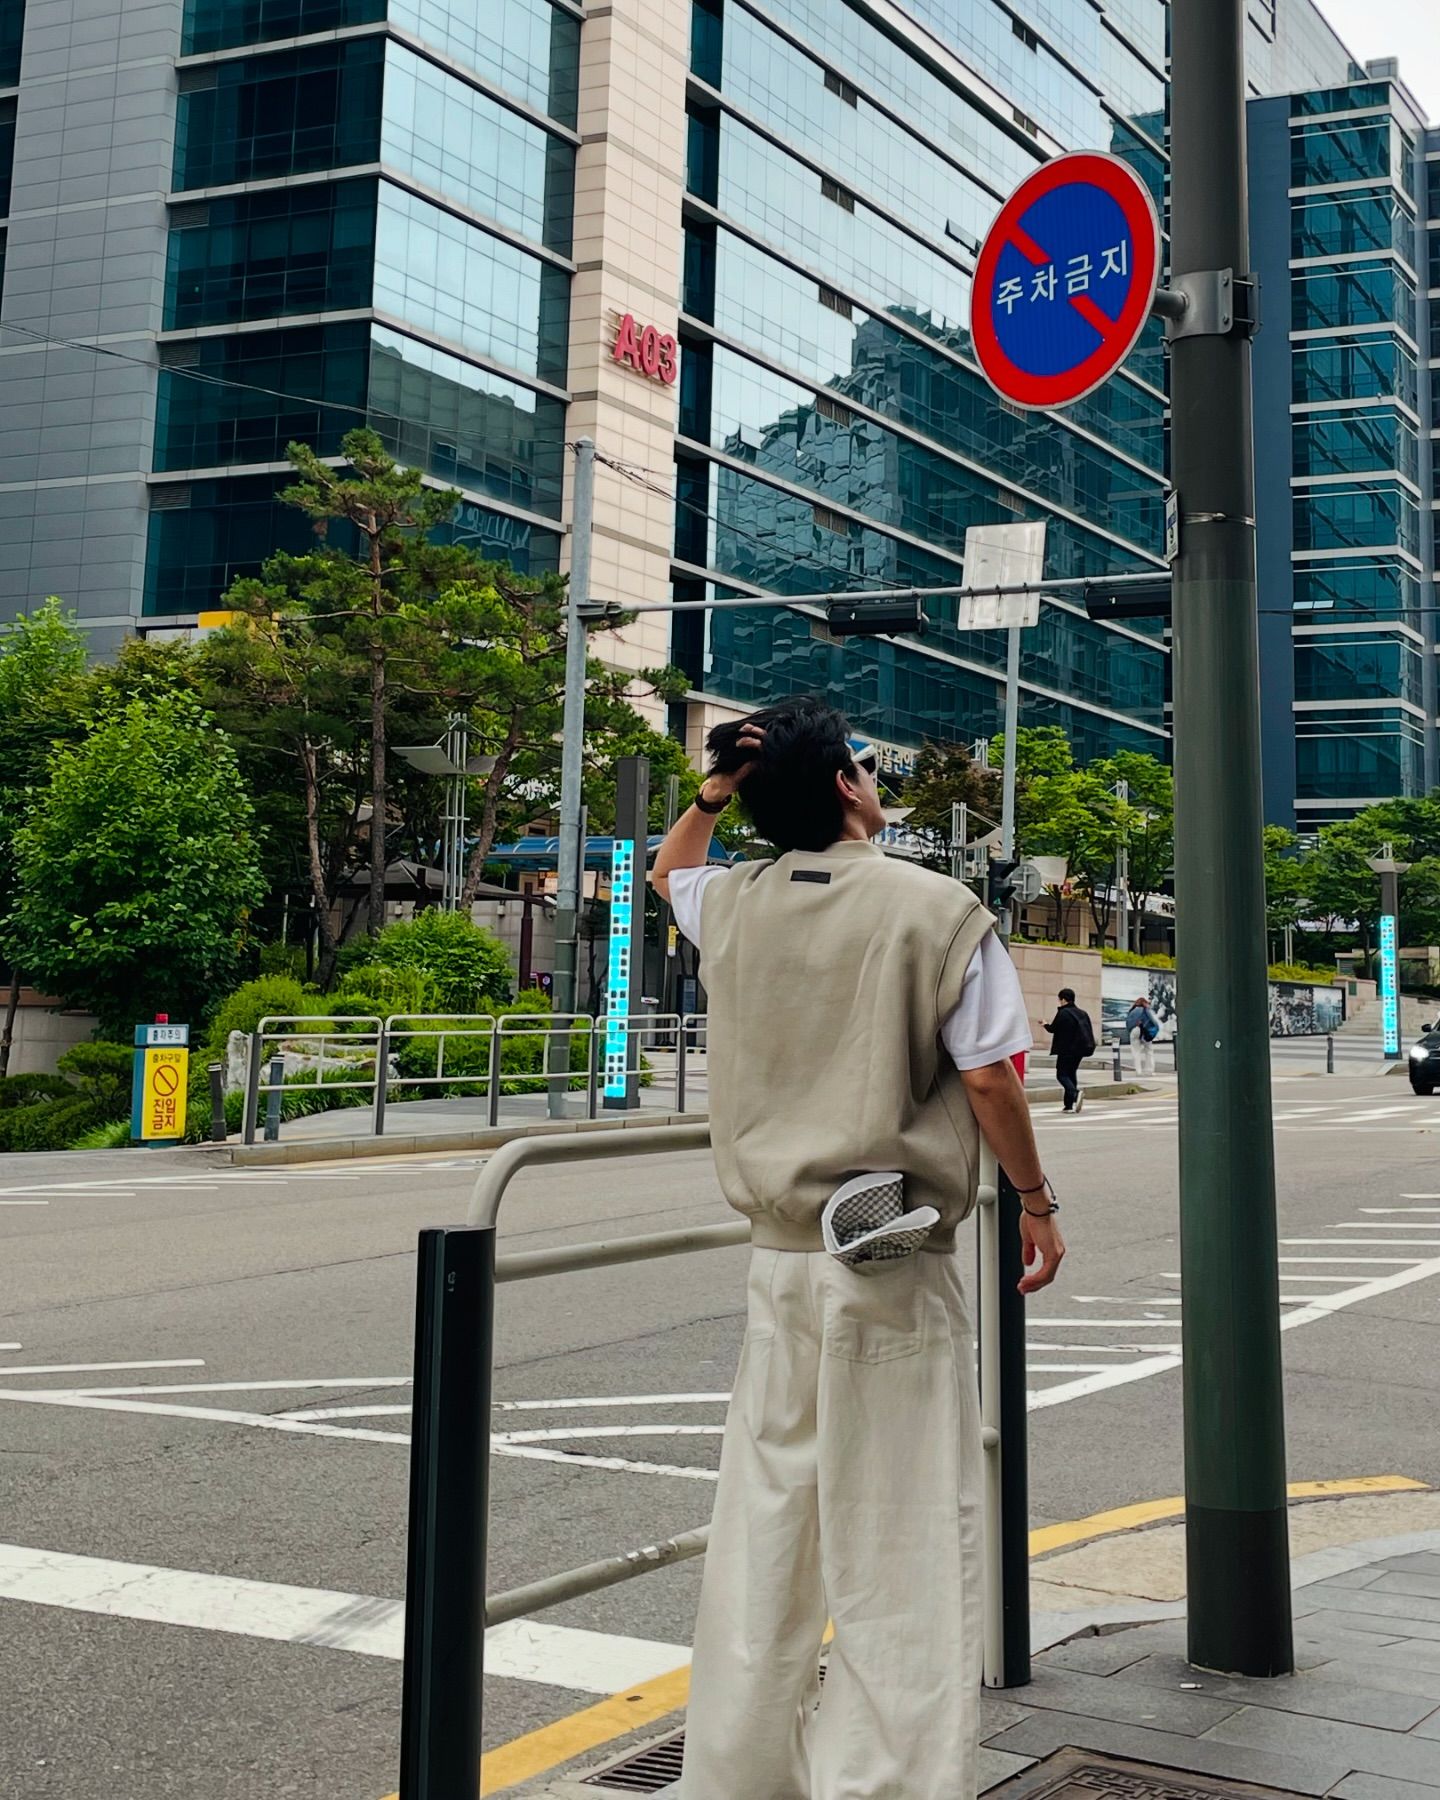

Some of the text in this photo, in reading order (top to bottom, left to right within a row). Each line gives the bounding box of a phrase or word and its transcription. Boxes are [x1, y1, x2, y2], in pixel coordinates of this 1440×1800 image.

[996, 239, 1128, 315] 주차금지
[614, 313, 677, 384] A03
[152, 1114, 176, 1130] 금지
[153, 1098, 176, 1114] 진입
